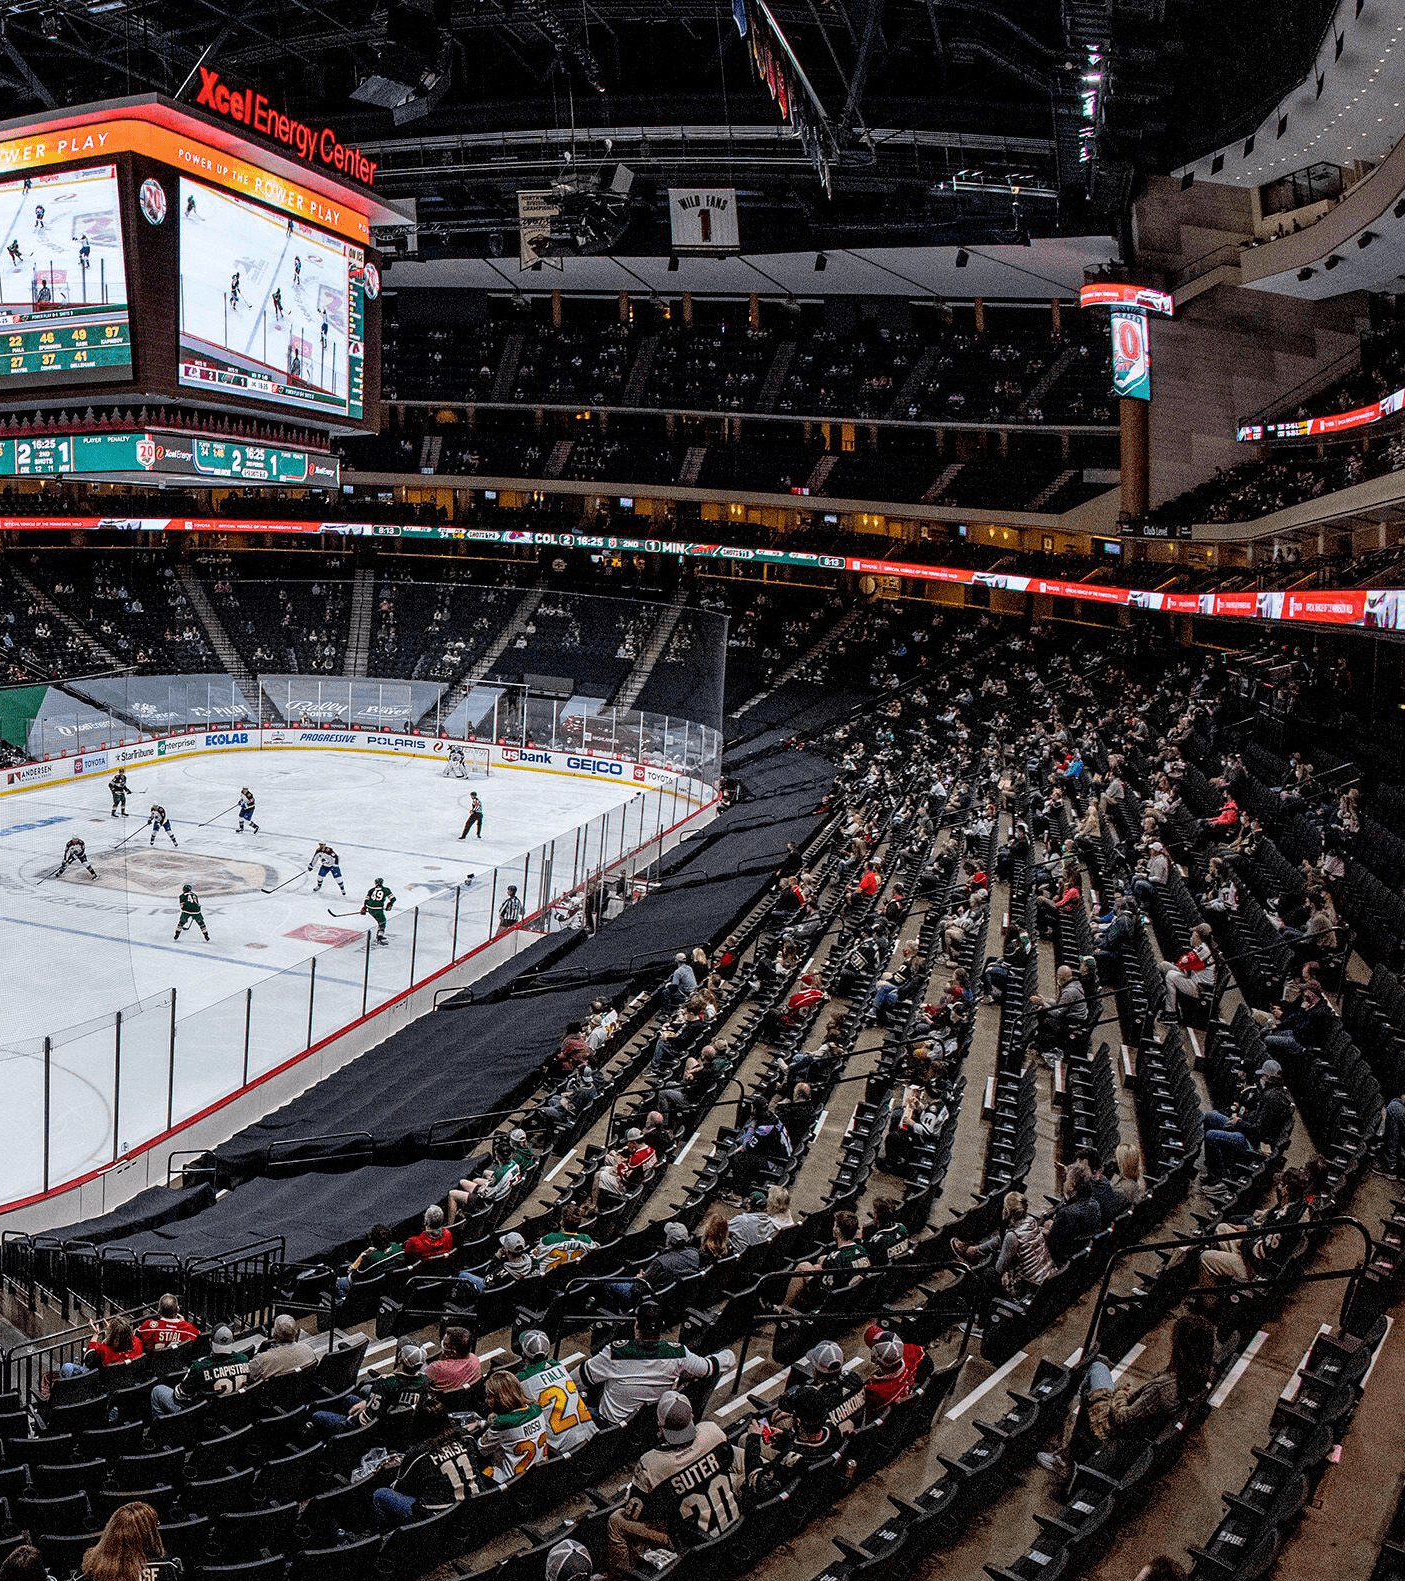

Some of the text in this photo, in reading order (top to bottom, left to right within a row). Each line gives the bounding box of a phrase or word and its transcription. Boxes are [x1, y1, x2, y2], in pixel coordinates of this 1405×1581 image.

[196, 66, 377, 187] Xcel Energy Center
[58, 132, 108, 154] PLAY
[178, 148, 340, 226] POWER UP THE POWER PLAY
[678, 195, 727, 211] WILD FANS
[698, 209, 711, 242] 1
[105, 326, 119, 338] 97
[9, 335, 23, 347] 22
[11, 356, 23, 367] 27
[42, 353, 55, 365] 37
[74, 350, 87, 362] 41
[32, 439, 56, 450] 16:25
[140, 445, 153, 457] 20
[18, 444, 31, 464] 2
[58, 442, 69, 463] 1
[232, 449, 241, 472] 2
[270, 455, 277, 476] 1
[378, 527, 394, 535] 8:13
[534, 533, 558, 544] COL
[563, 536, 571, 544] 2
[576, 536, 604, 547] 16:25
[649, 541, 655, 550] 1
[662, 541, 684, 553] MIN
[824, 557, 840, 566] 8:13
[160, 738, 196, 751] enterprise
[205, 732, 249, 746] ECOLAB
[299, 733, 357, 743] PROGRESSIVE
[367, 736, 426, 749] POLARIS
[121, 747, 155, 762] StarTribune
[503, 750, 552, 764] us bank
[84, 757, 105, 768] TOYOTA
[567, 757, 623, 775] GEICO
[22, 765, 52, 778] ANDERSEN
[648, 771, 673, 784] TOYOTA
[370, 890, 385, 901] 49
[159, 1331, 181, 1342] STAAL
[203, 1370, 213, 1381] B.
[540, 1366, 567, 1386] FIALA
[367, 1393, 382, 1410] 75
[523, 1419, 542, 1438] ROSSI
[440, 1454, 480, 1501] 11
[670, 1453, 720, 1495] SUTER
[679, 1474, 741, 1538] 20
